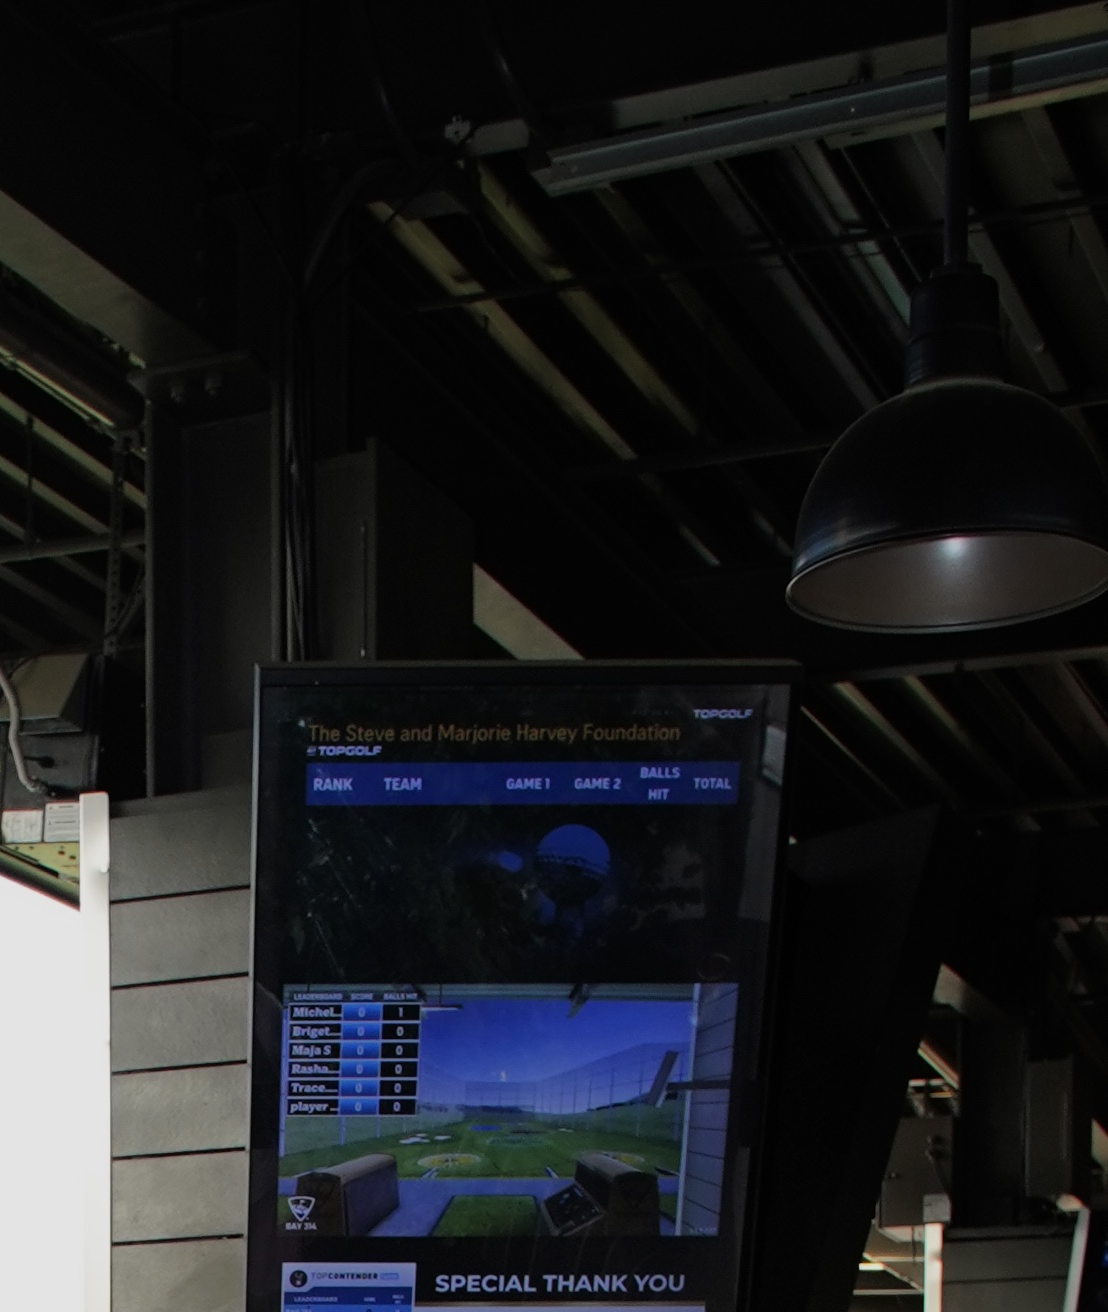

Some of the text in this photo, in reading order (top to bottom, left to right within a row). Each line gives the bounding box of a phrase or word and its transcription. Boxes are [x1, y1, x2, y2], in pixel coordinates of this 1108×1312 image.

[693, 708, 754, 719] TOPGOLF
[308, 722, 681, 745] The Steve and Marjorie Harvey Foundation
[317, 745, 383, 757] TOPGOLF
[639, 766, 681, 779] BALLS
[312, 777, 354, 791] RANK
[383, 777, 423, 791] TEAM
[506, 777, 551, 790] GAME 1
[574, 777, 622, 790] GAME 2
[693, 777, 732, 790] TOTAL
[648, 788, 670, 801] HIT
[358, 1007, 366, 1018] 0
[398, 1007, 404, 1017] 1
[357, 1026, 365, 1037] 0
[396, 1026, 404, 1037] 0
[292, 1045, 332, 1057] Maja S
[357, 1045, 364, 1056] 0
[395, 1045, 403, 1056] 0
[356, 1064, 364, 1075] 0
[394, 1064, 403, 1075] 0
[355, 1082, 363, 1093] 0
[394, 1083, 402, 1093] 0
[354, 1102, 362, 1112] 0
[393, 1102, 401, 1112] 0
[285, 1222, 302, 1231] BAY
[435, 1273, 685, 1293] SPECIAL THANK YOU
